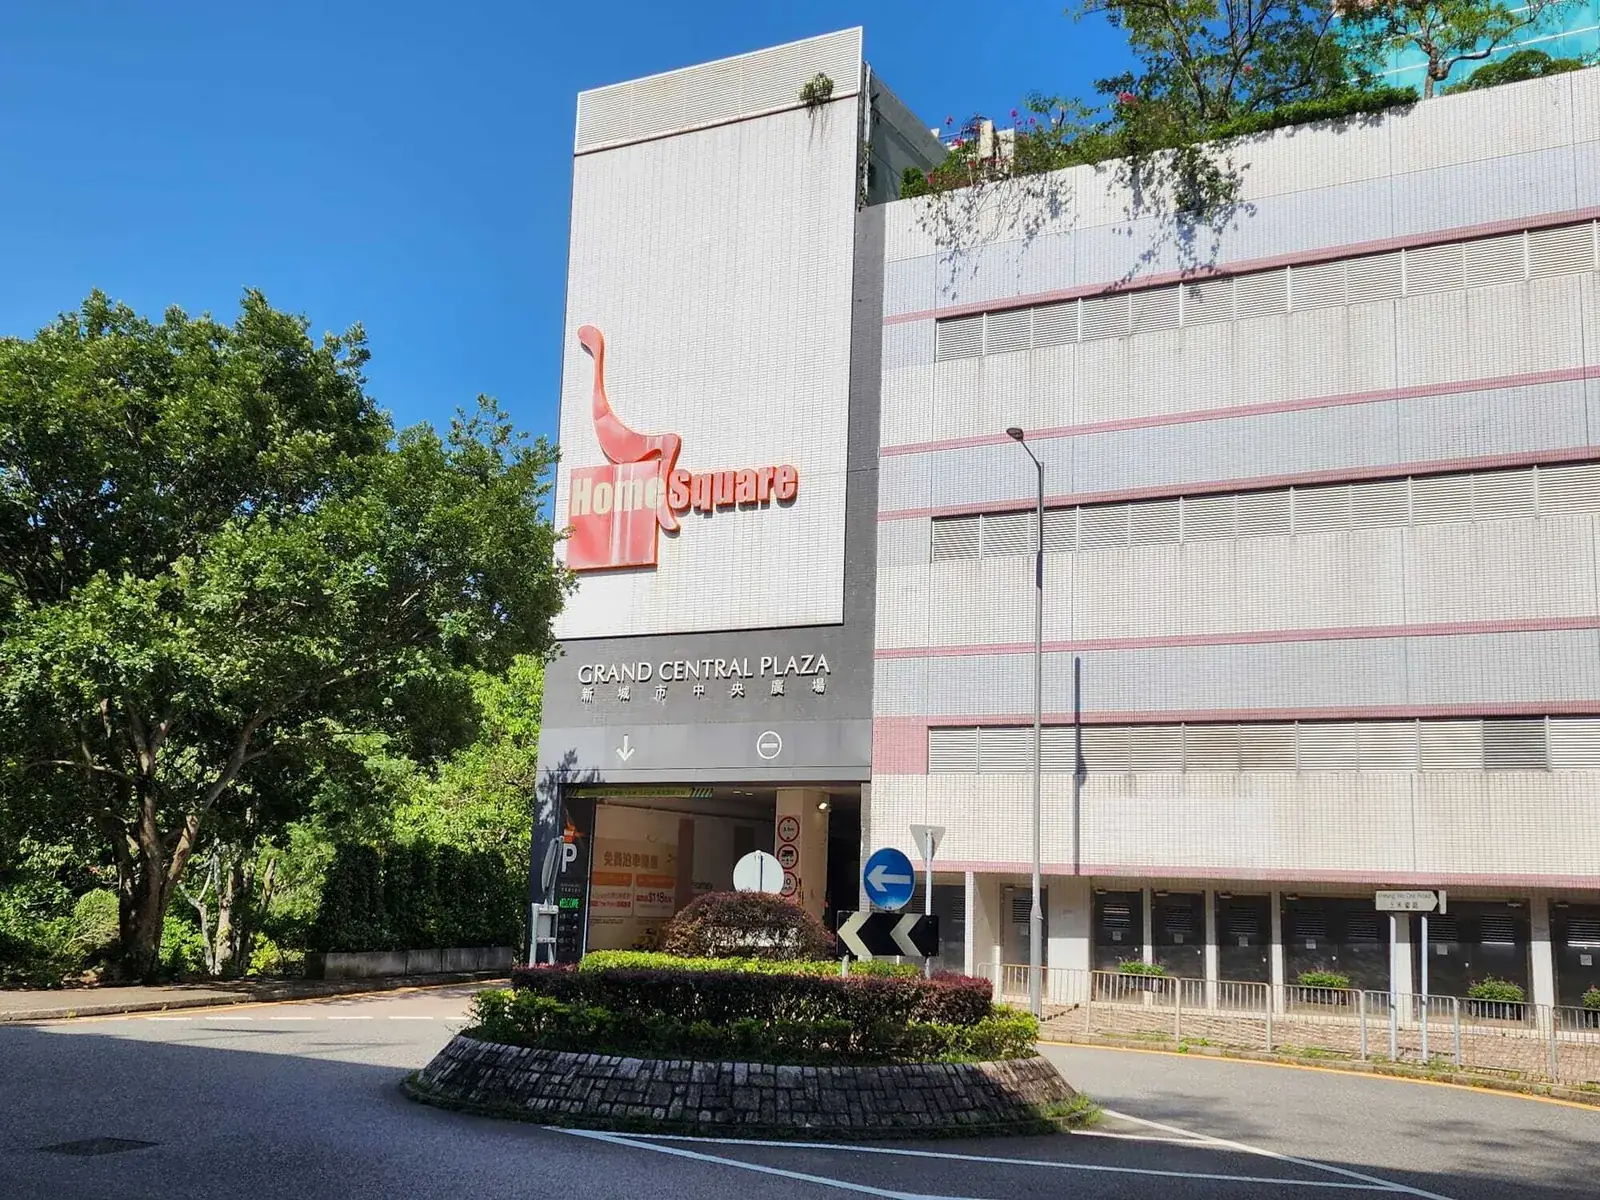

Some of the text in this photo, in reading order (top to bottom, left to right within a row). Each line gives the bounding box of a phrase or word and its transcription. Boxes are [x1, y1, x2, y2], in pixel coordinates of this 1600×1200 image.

[577, 653, 831, 684] GRAND CENTRAL PLAZA
[580, 678, 827, 704] 新城市中央廣場
[561, 843, 577, 873] P
